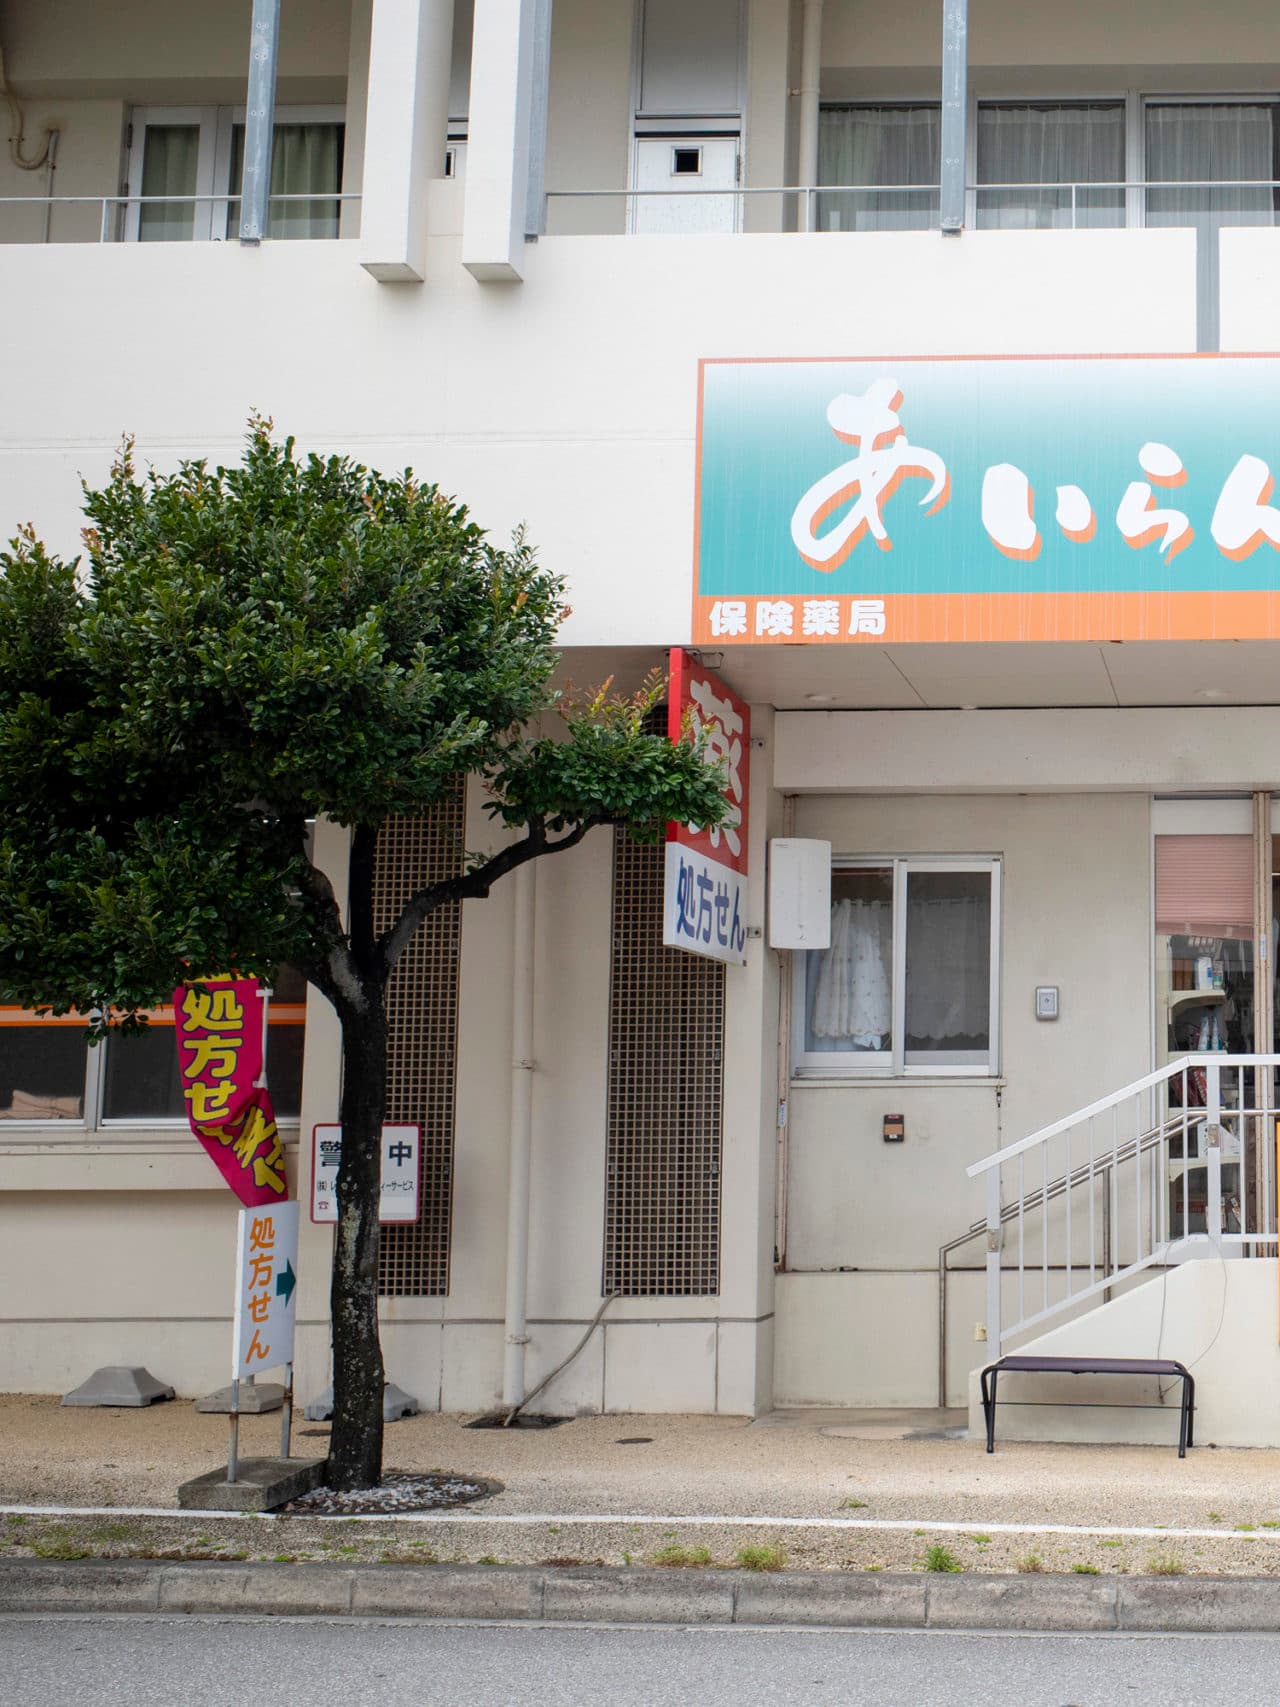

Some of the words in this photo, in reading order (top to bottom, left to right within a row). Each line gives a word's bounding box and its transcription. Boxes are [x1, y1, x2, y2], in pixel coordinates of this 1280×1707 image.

[709, 600, 886, 636] 保険薬局
[677, 855, 746, 953] 処方せん
[320, 1140, 412, 1167] 警中
[244, 1216, 276, 1365] 処方せん
